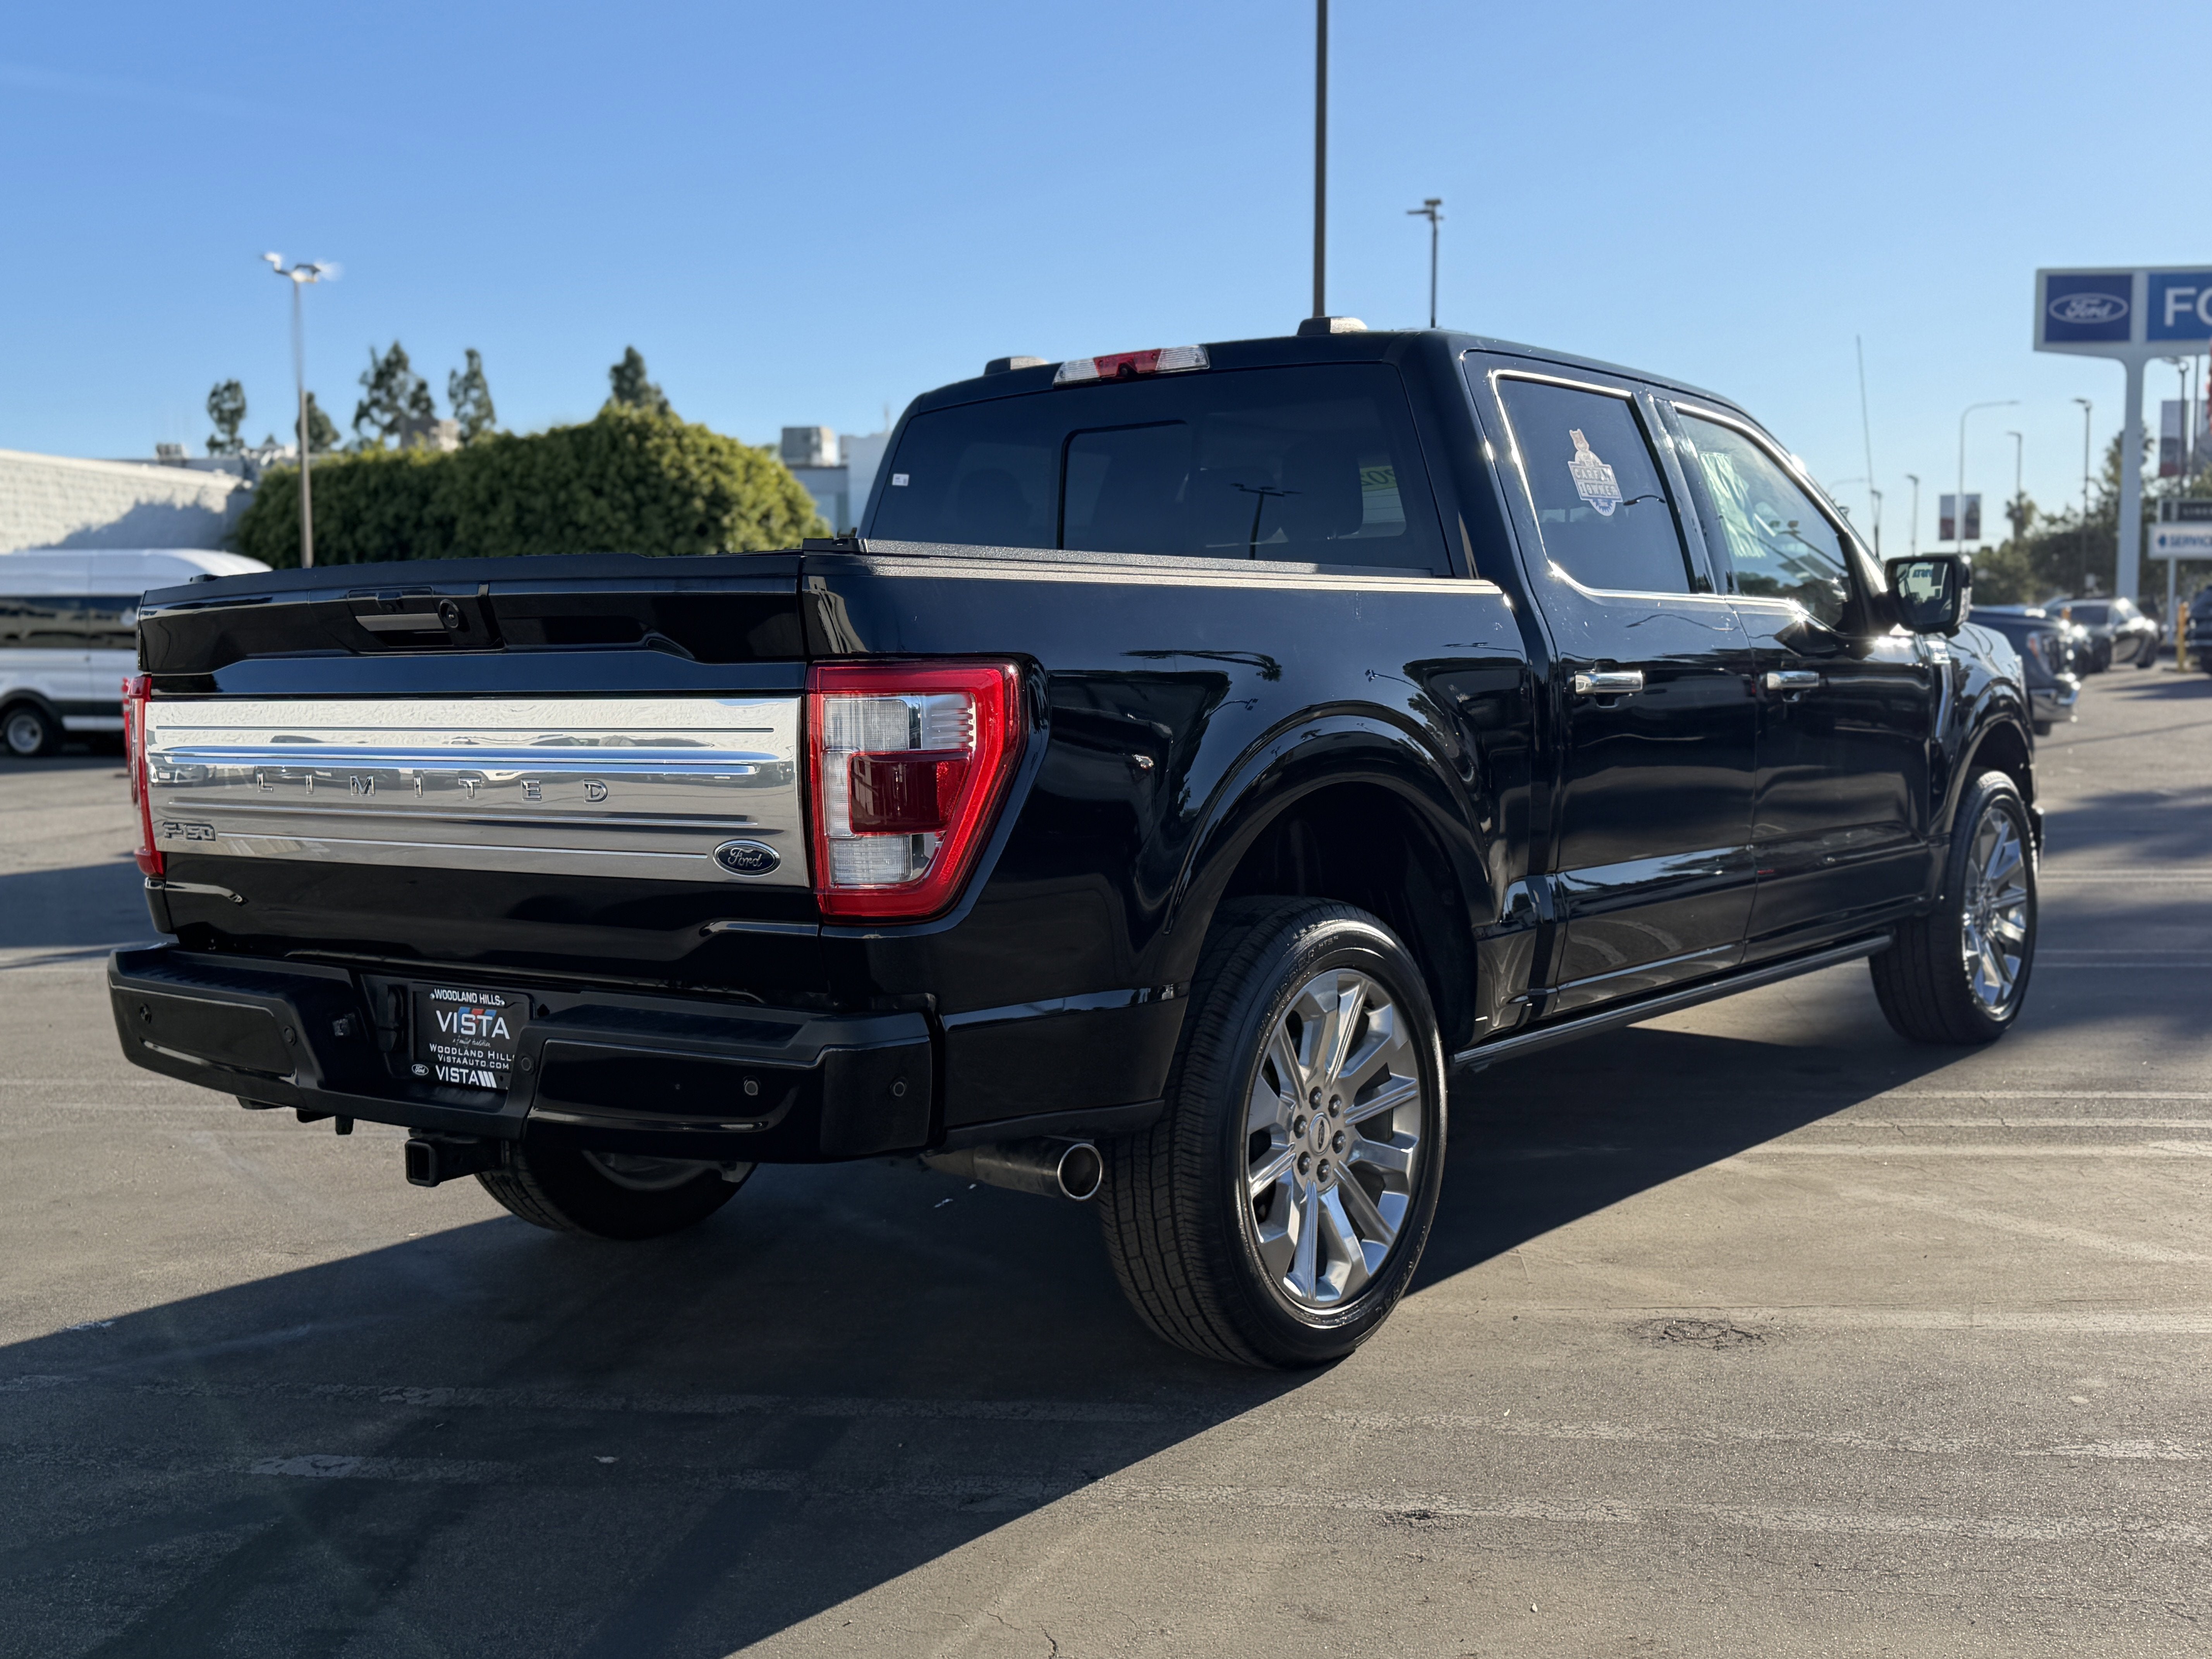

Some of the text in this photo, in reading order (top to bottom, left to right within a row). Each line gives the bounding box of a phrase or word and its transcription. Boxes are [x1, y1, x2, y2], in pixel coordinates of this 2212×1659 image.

[2065, 299, 2113, 319] Ford
[1574, 467, 1614, 482] CARFAX
[257, 773, 608, 803] LIMITED
[163, 822, 216, 841] F-150
[728, 847, 763, 867] Ford
[434, 988, 500, 1006] WOODLAND HILLS
[436, 1010, 510, 1039] VISTA
[429, 1043, 484, 1058] WOODLAND
[435, 1065, 479, 1086] VISTA
